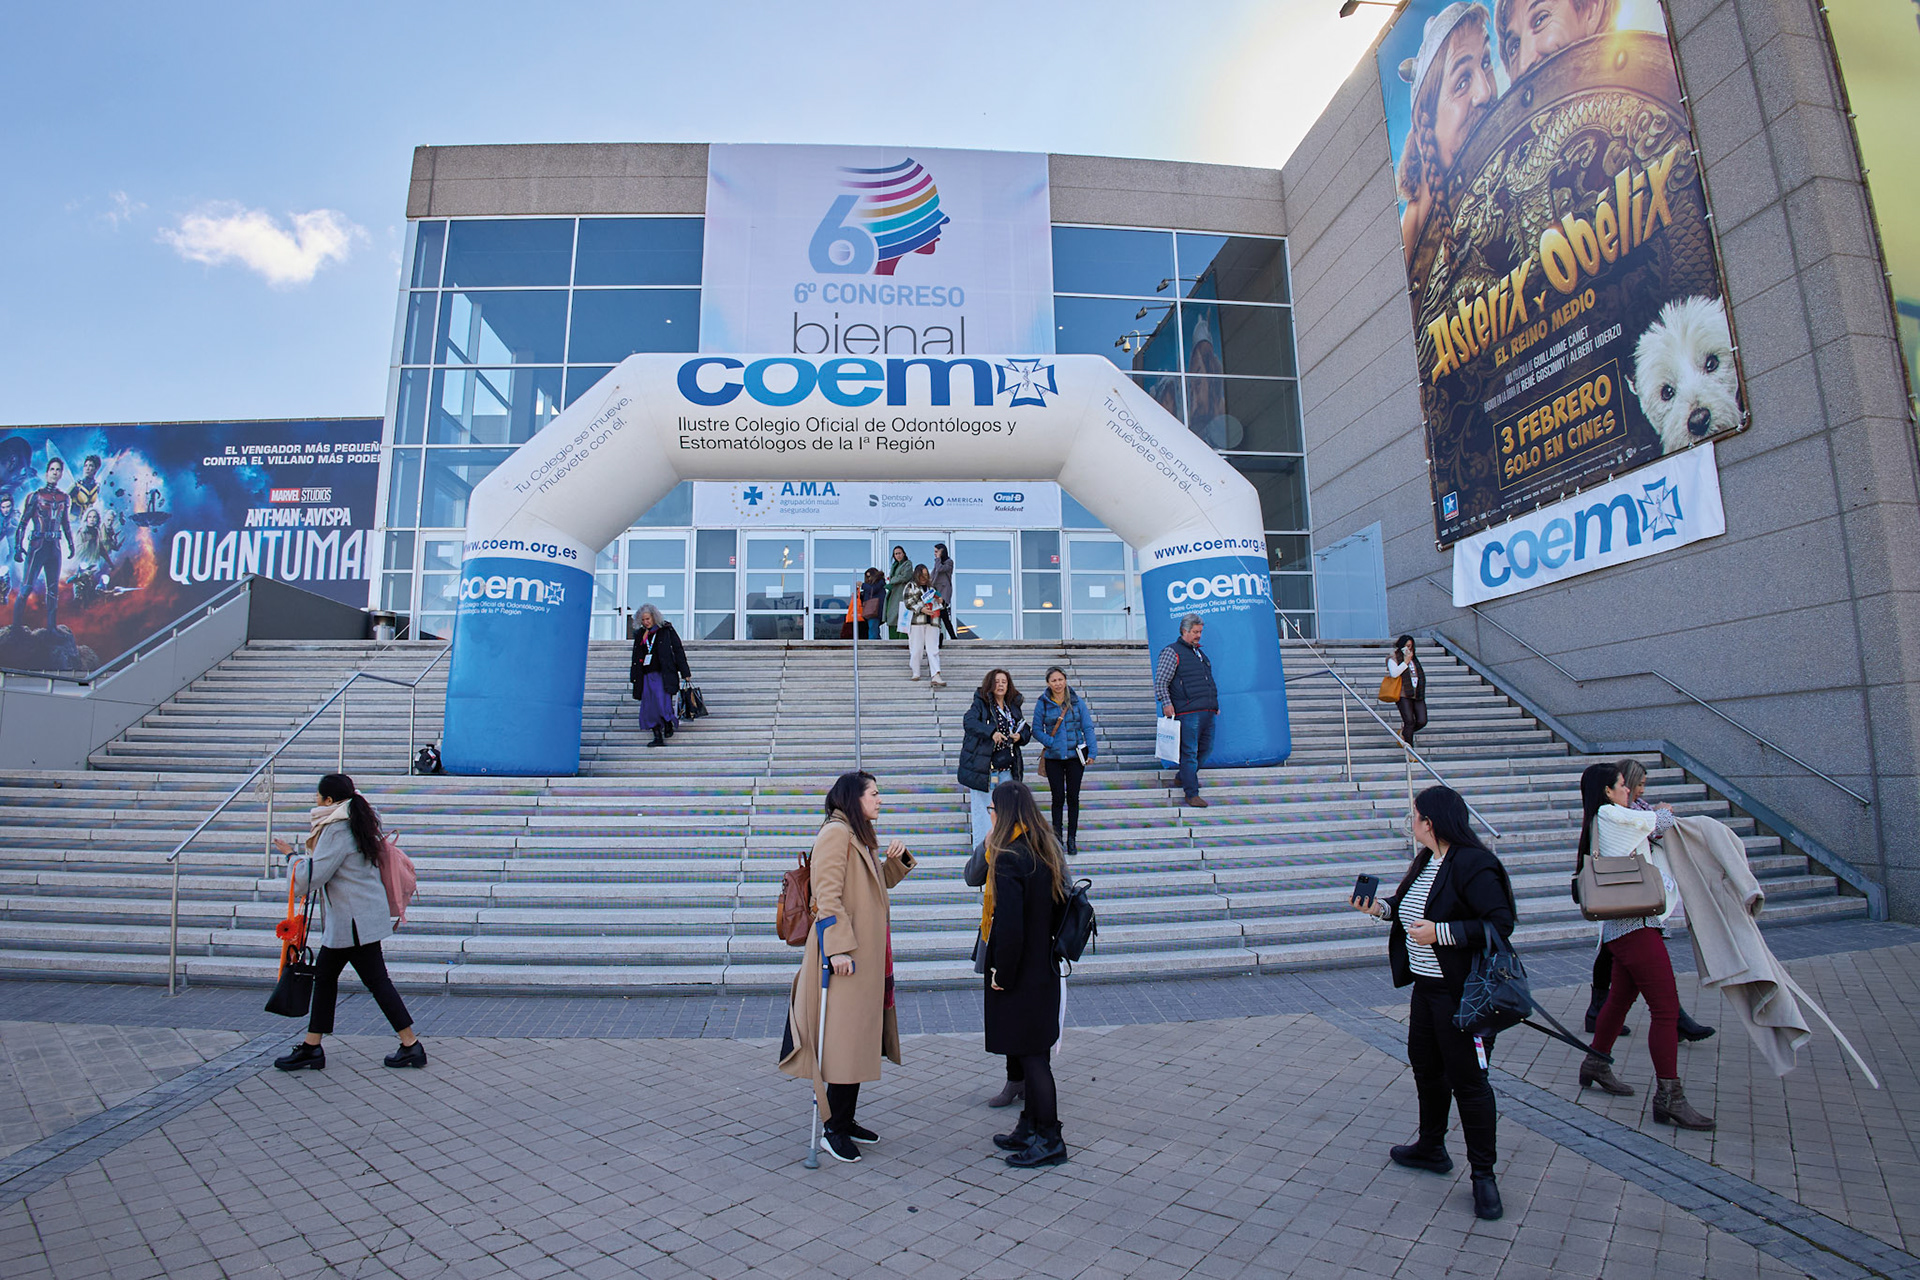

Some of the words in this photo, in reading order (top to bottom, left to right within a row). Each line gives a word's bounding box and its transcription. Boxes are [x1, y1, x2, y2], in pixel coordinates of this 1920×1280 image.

[808, 194, 876, 275] 6
[822, 282, 965, 308] CONGRESO
[793, 311, 966, 355] bienal
[1427, 256, 1532, 384] Astérix
[1494, 346, 1509, 368] EL
[1510, 320, 1548, 358] REINO
[1551, 288, 1596, 333] MEDIO
[1521, 371, 1536, 391] RENÉ
[1570, 340, 1594, 364] ALBERT
[1594, 323, 1622, 348] UDERZO
[1534, 338, 1568, 369] GUILLAUME
[1568, 325, 1589, 347] CANET
[677, 357, 994, 407] coem
[678, 416, 731, 432] Ilustre
[734, 416, 801, 435] Colegio
[805, 416, 860, 432] Oficial
[864, 417, 886, 432] de
[890, 417, 1003, 436] Odontólogos
[1006, 420, 1017, 436] y
[1500, 426, 1515, 454] 3
[1517, 374, 1612, 447] FEBRERO
[203, 457, 247, 466] CONTRA
[251, 456, 264, 466] EL
[267, 455, 314, 465] VILLANO
[318, 451, 344, 464] MÁS
[225, 446, 238, 455] EL
[241, 444, 302, 455] VENGADOR
[305, 442, 330, 453] MÁS
[513, 481, 531, 494] Tu
[530, 443, 574, 481] Colegio
[574, 430, 590, 446] se
[589, 397, 633, 433] mueve,
[538, 448, 590, 494] muévete
[589, 429, 613, 450] con
[680, 435, 806, 452] Estomatólogos
[812, 436, 834, 450] de
[839, 436, 853, 450] la
[876, 435, 936, 453] Región
[1103, 396, 1118, 413] Tu
[1117, 410, 1159, 448] Colegio
[1158, 446, 1174, 460] se
[1173, 459, 1213, 496] mueve,
[1106, 420, 1156, 463] muévete
[1155, 461, 1178, 482] con
[1504, 446, 1541, 479] SOLO
[1543, 433, 1564, 461] EN
[1567, 409, 1616, 450] CINES
[270, 489, 300, 502] MARVEL
[301, 489, 332, 501] STUDIOS
[780, 482, 841, 497] A.M.A.
[244, 508, 301, 527] ANT-MAN
[303, 507, 351, 526] AVISPA
[1480, 493, 1642, 588] coem
[460, 575, 544, 602] coem
[1167, 573, 1262, 604] coem
